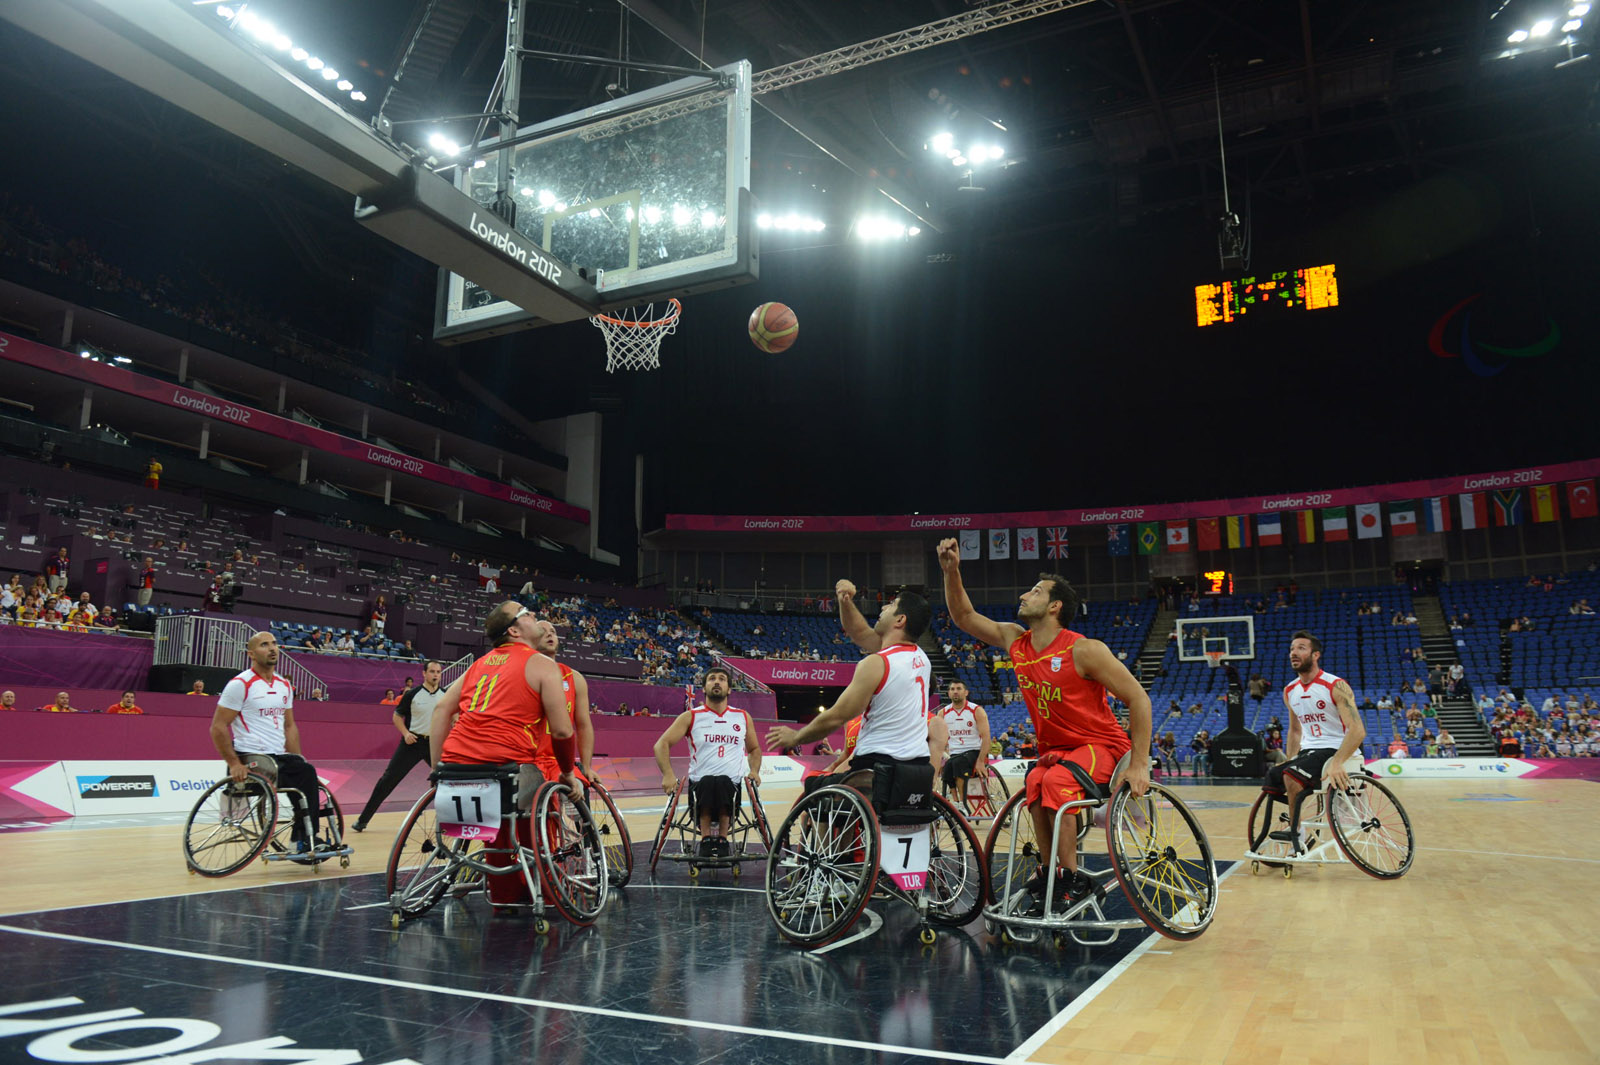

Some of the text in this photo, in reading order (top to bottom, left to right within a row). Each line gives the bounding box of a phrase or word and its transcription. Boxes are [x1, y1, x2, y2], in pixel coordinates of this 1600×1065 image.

[470, 212, 562, 285] London 2012
[173, 390, 251, 423] London 2012
[367, 448, 424, 474] London 2012
[1464, 470, 1543, 489] London 2012
[510, 490, 552, 511] London 2012
[1262, 493, 1332, 509] London 2012
[910, 517, 971, 528] London 2012
[1080, 508, 1145, 522] London 2012
[744, 518, 804, 528] London 2012
[771, 667, 836, 681] London 2012
[467, 674, 499, 712] 11
[704, 734, 740, 745] TÜRKİYE
[718, 745, 725, 758] 8
[80, 782, 153, 791] POWERADE
[451, 795, 484, 823] 11
[461, 825, 481, 838] ESP
[897, 837, 913, 869] 7
[901, 874, 922, 888] TUR
